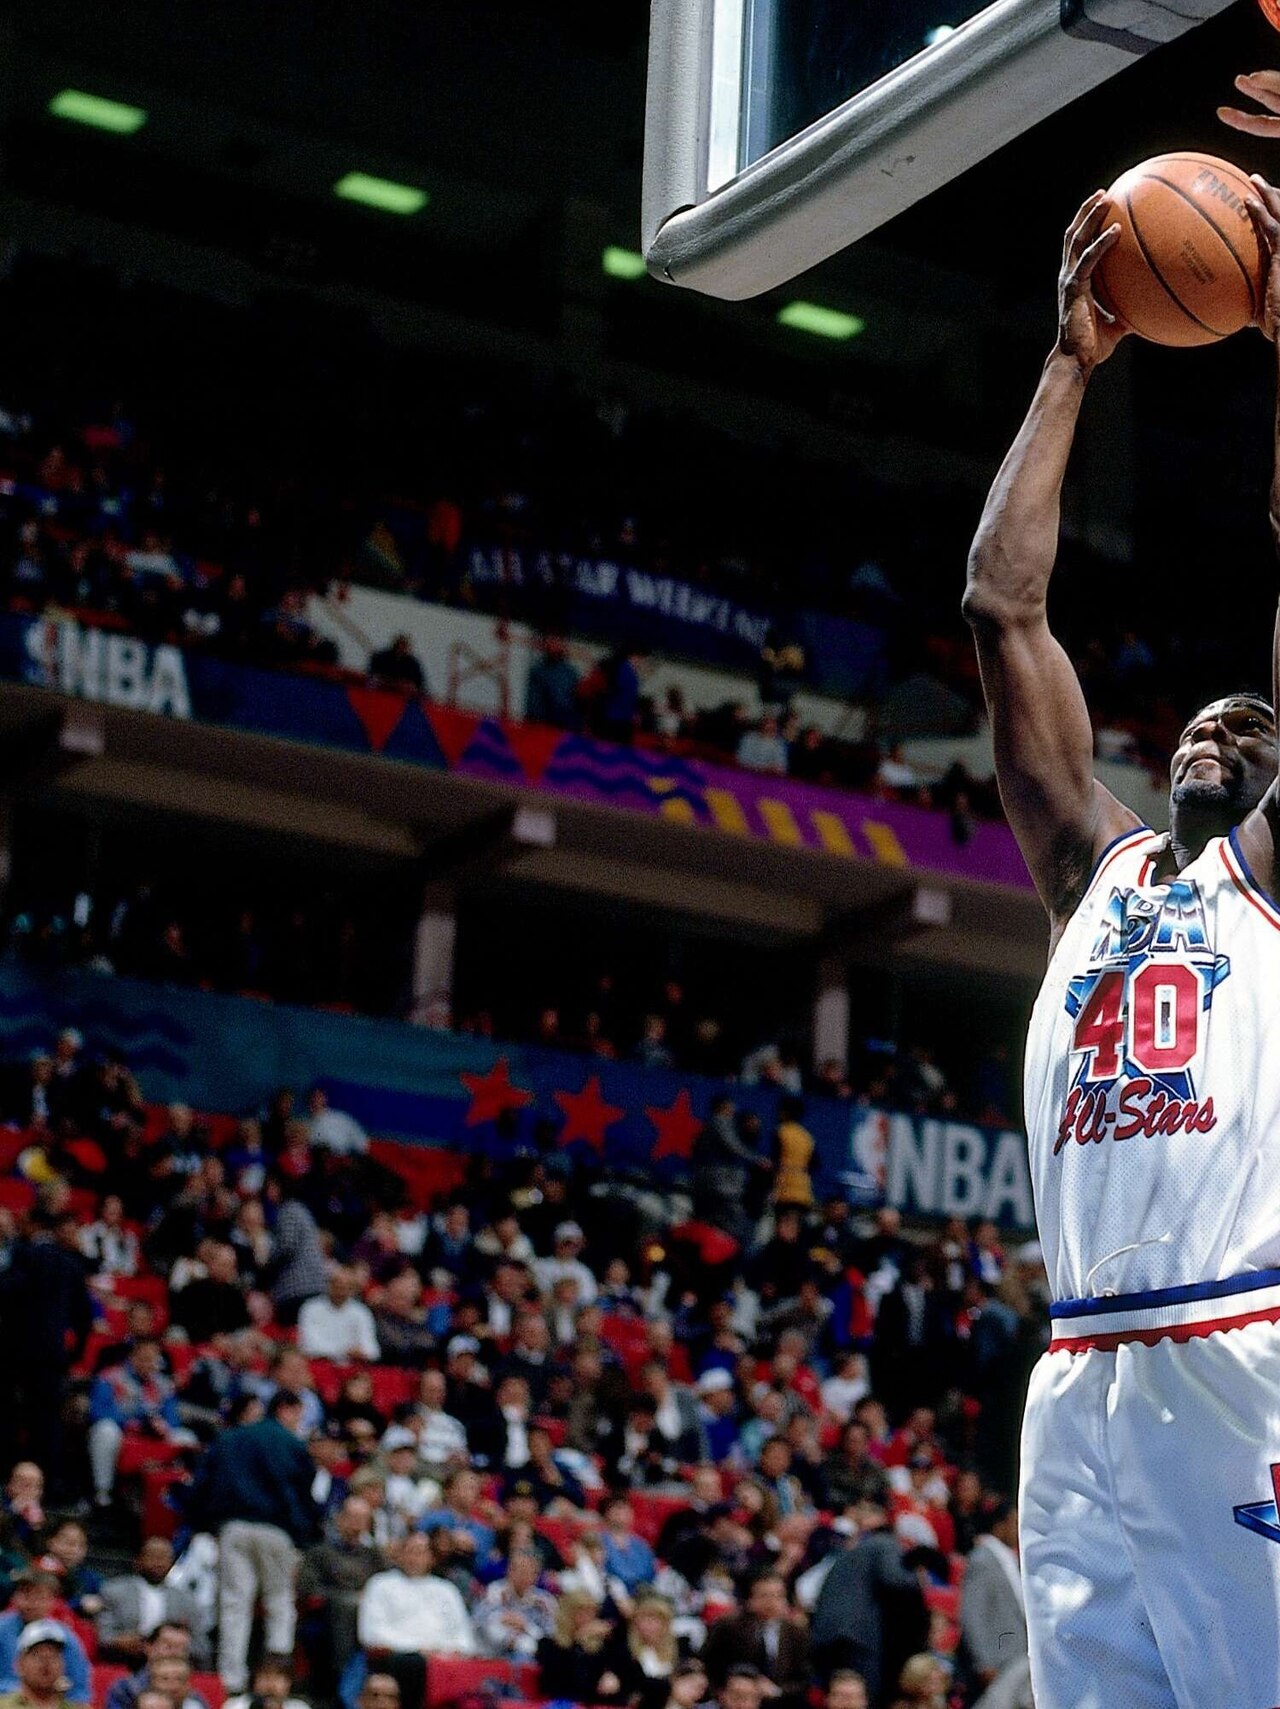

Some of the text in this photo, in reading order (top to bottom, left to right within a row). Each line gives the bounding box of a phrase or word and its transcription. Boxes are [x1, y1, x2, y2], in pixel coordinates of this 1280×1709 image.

[58, 619, 192, 721] NBA
[1070, 962, 1200, 1081] 40
[887, 1111, 1035, 1229] NBA
[1053, 1077, 1218, 1156] All-Stars
